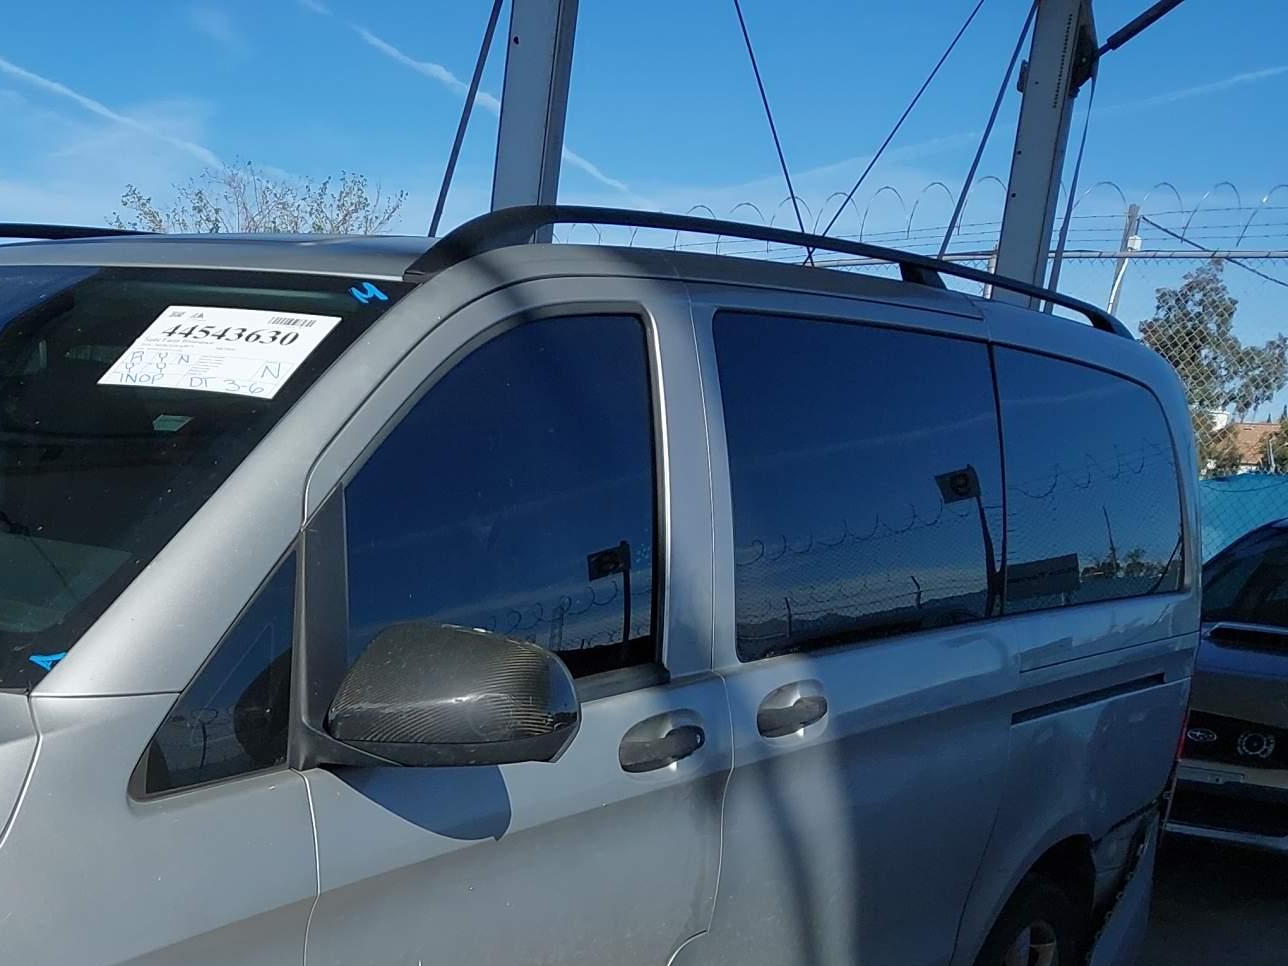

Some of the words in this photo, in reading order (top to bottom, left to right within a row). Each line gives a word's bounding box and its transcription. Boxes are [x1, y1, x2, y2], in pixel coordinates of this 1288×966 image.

[161, 323, 300, 346] 44543630
[177, 354, 190, 365] N
[260, 362, 282, 379] N
[119, 372, 165, 385] INOP
[223, 379, 265, 394] 3-6
